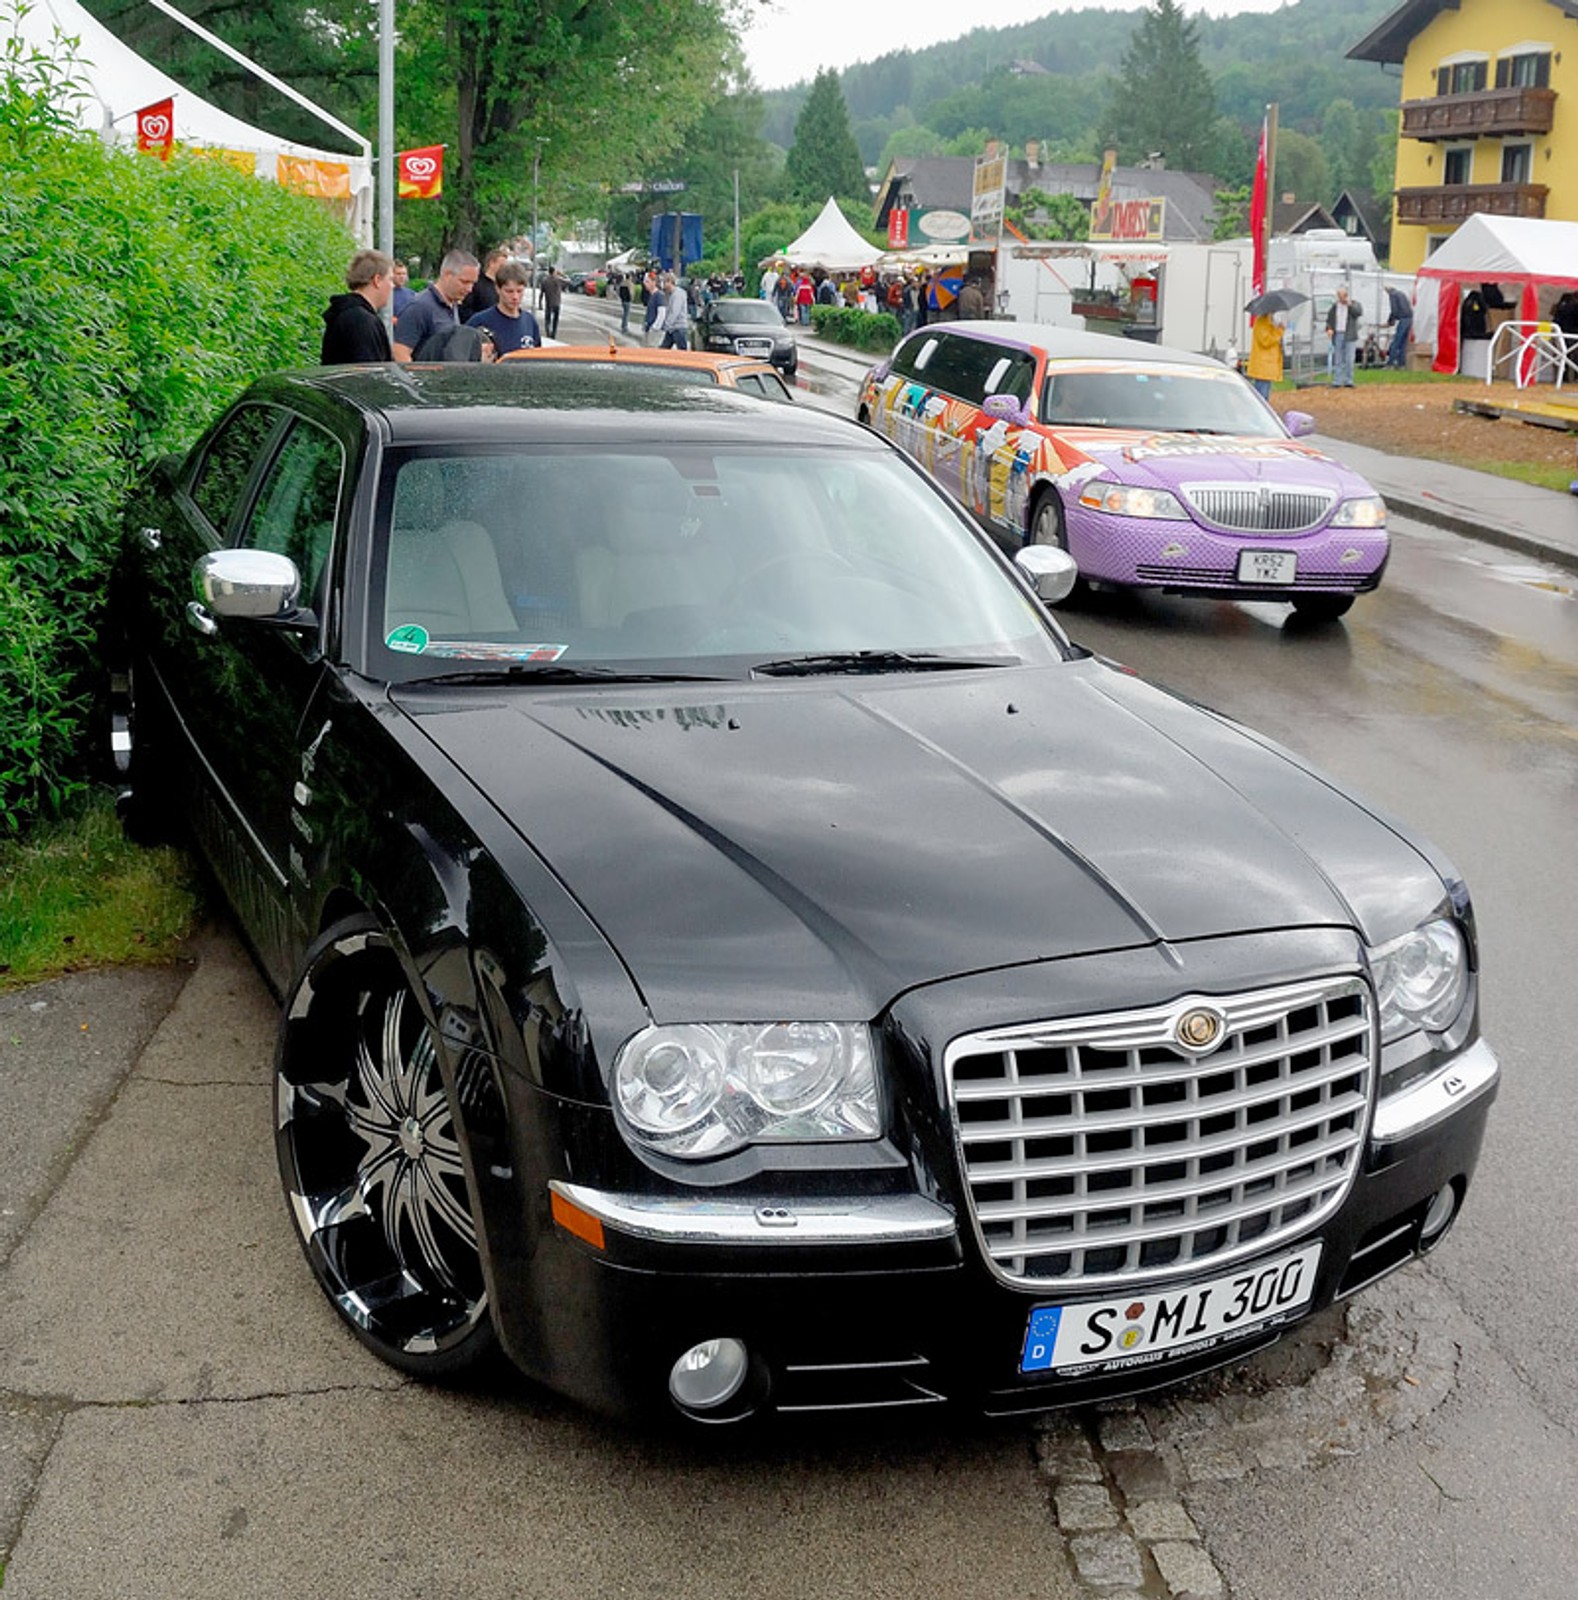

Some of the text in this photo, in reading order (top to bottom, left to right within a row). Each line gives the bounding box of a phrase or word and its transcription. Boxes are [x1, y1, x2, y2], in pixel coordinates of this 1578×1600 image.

[1080, 1258, 1303, 1354] S MI 300
[1032, 1345, 1045, 1359] D
[1103, 1351, 1163, 1371] AUTOHAUS
